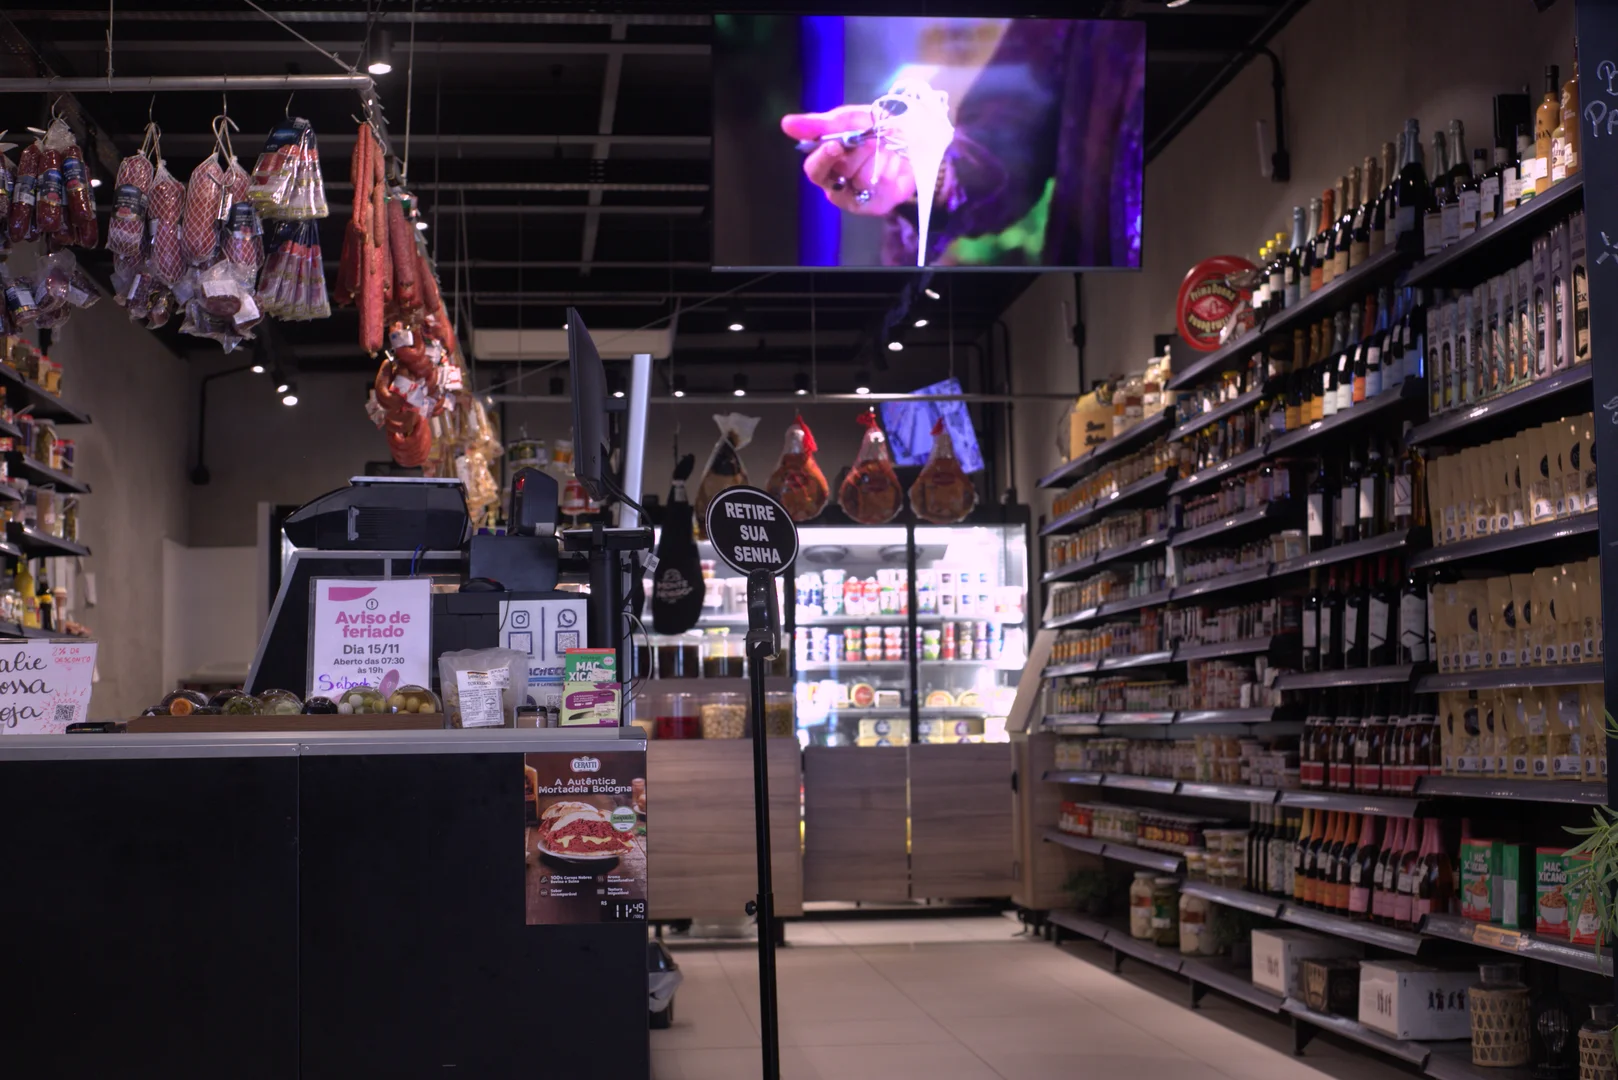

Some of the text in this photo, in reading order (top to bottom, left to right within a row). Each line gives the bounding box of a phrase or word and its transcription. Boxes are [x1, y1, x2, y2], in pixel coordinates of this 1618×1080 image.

[725, 502, 776, 521] RETIRE
[740, 524, 769, 542] SUA
[734, 545, 782, 564] SENHA
[335, 611, 411, 624] Aviso de
[342, 625, 404, 638] feriado
[343, 643, 400, 655] Dia 15/11
[333, 658, 362, 666] Aberto
[381, 657, 405, 665] 07:30
[576, 661, 600, 671] MAC
[573, 761, 597, 769] CERATTI
[568, 777, 617, 786] Autêntica
[539, 785, 632, 794] Mortadela Bologna
[1543, 861, 1562, 872] MAC
